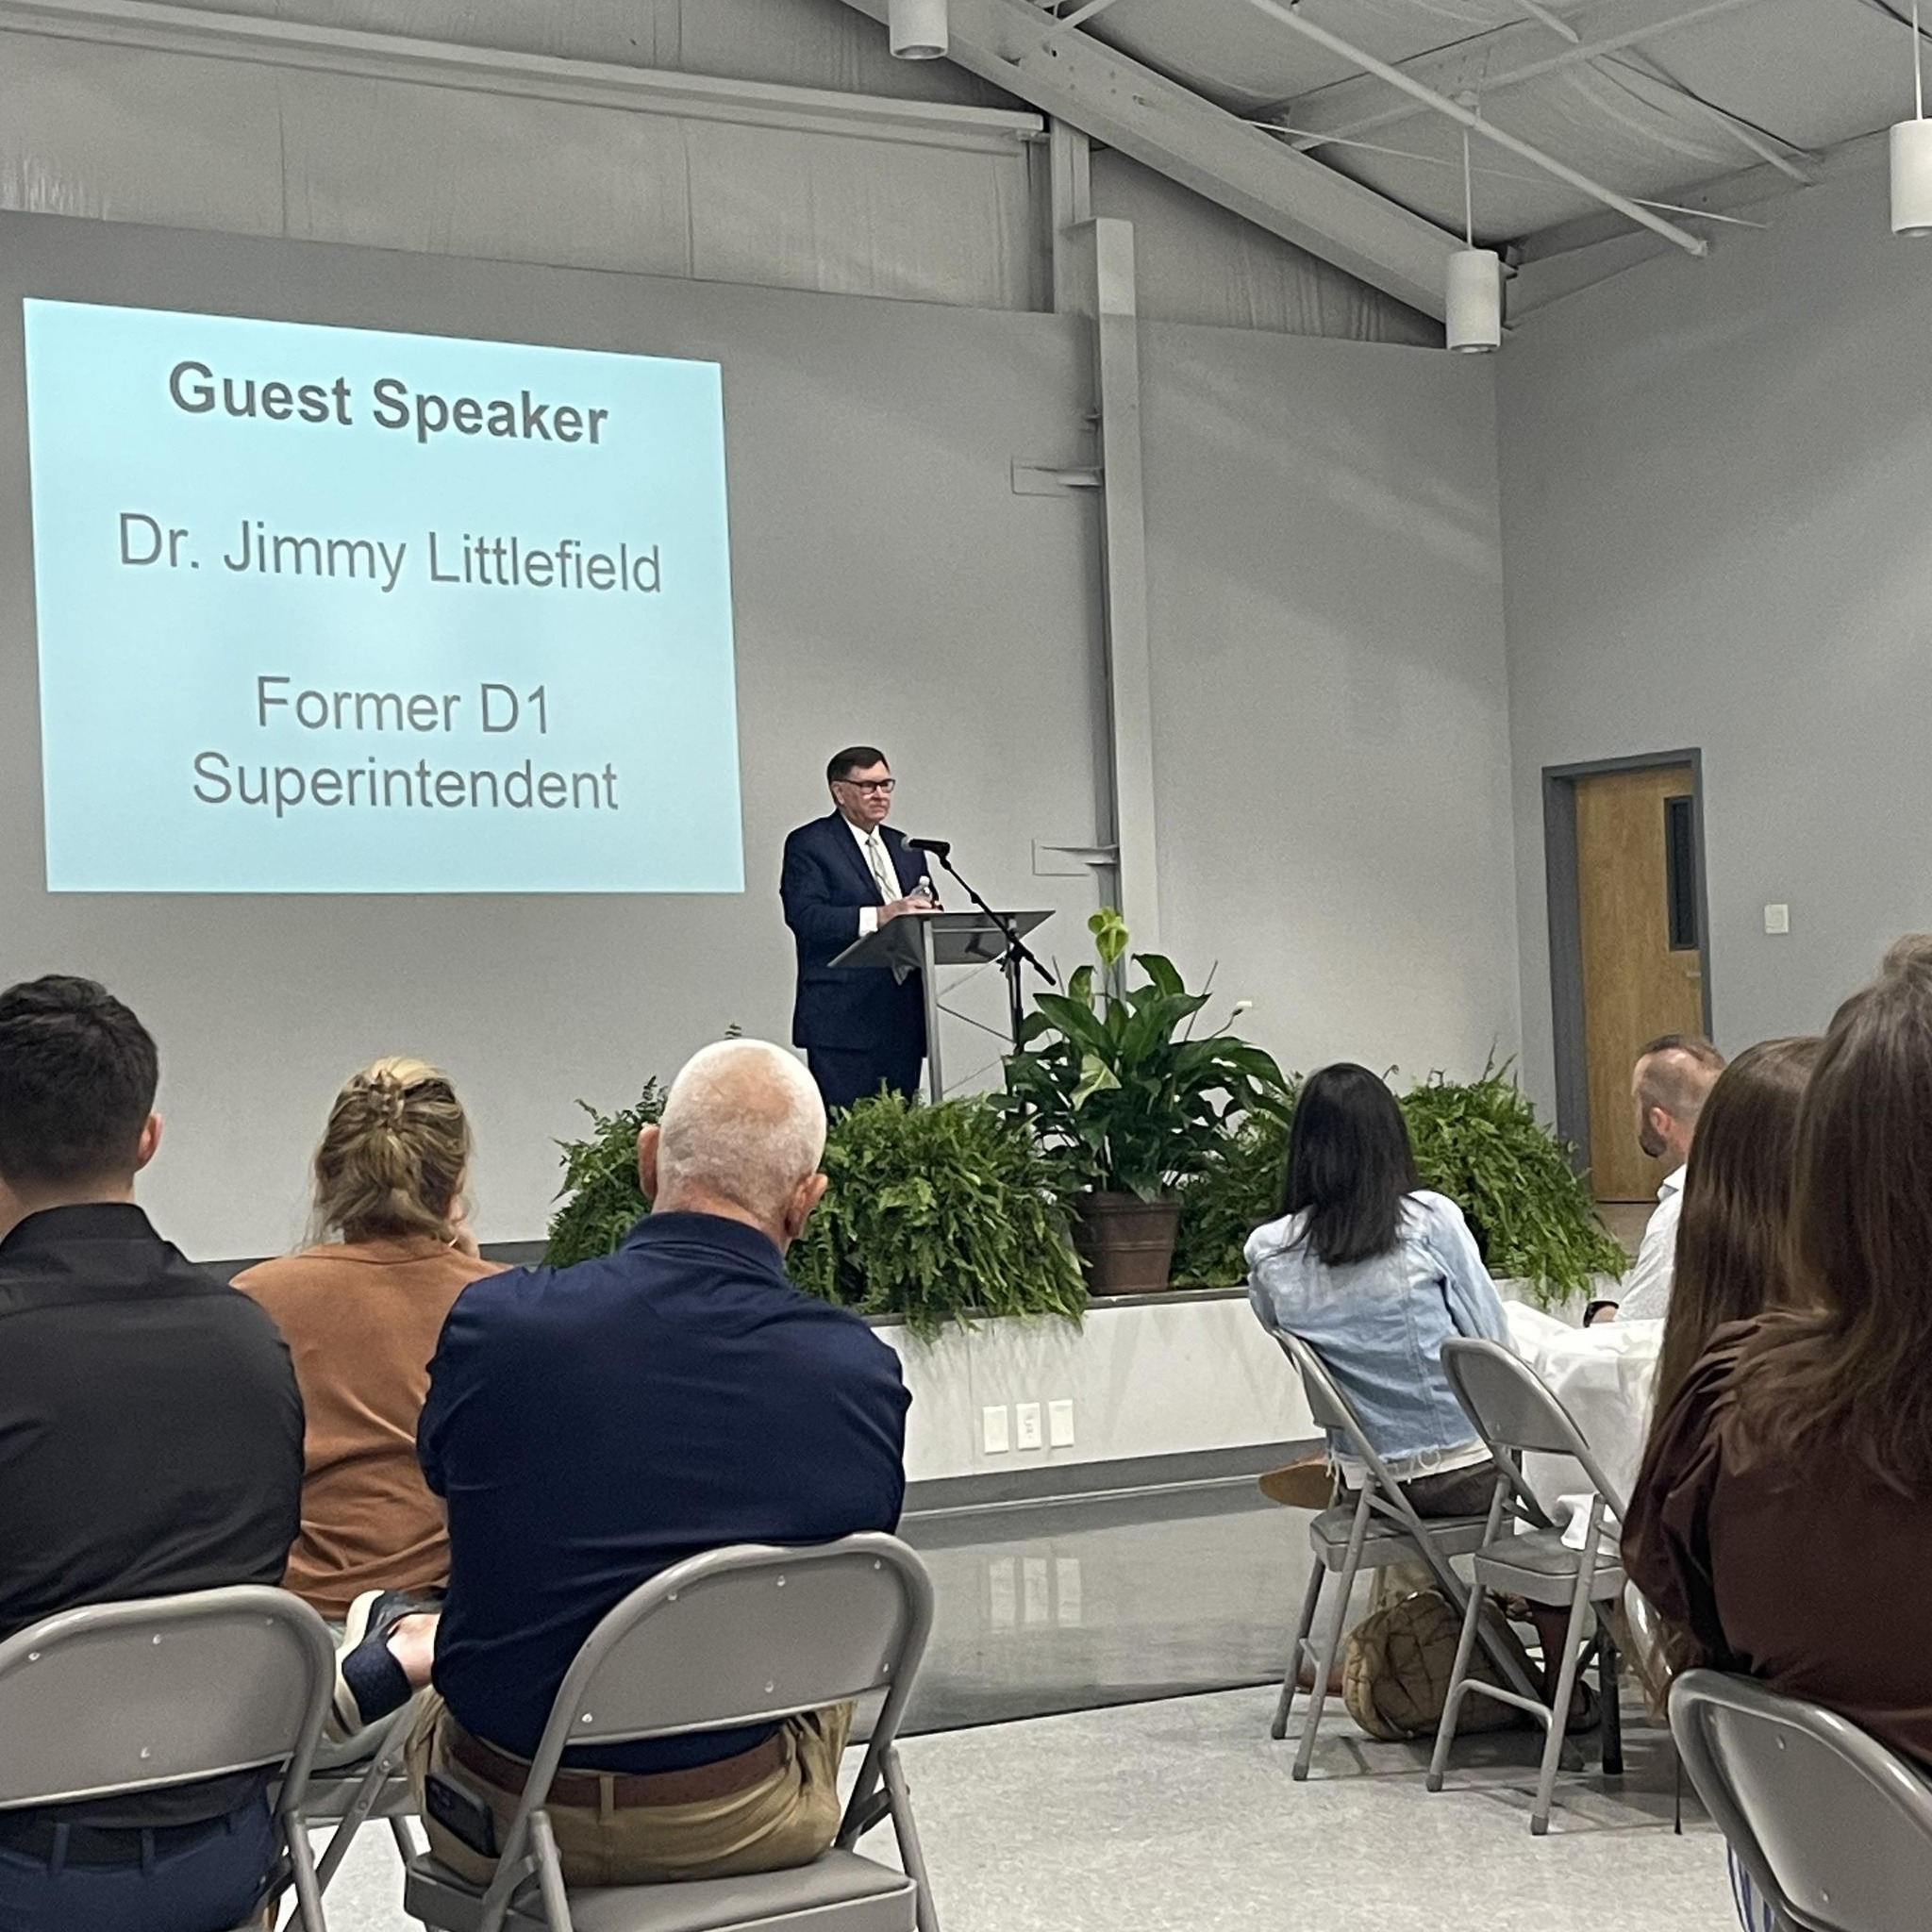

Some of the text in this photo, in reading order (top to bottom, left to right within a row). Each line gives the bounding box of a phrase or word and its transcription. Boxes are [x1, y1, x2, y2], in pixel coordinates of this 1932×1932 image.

[169, 360, 608, 444] Guest Speaker
[119, 512, 661, 593] Dr. Jimmy Littlefield
[257, 675, 550, 735] Former D1
[192, 751, 619, 819] Superintendent
